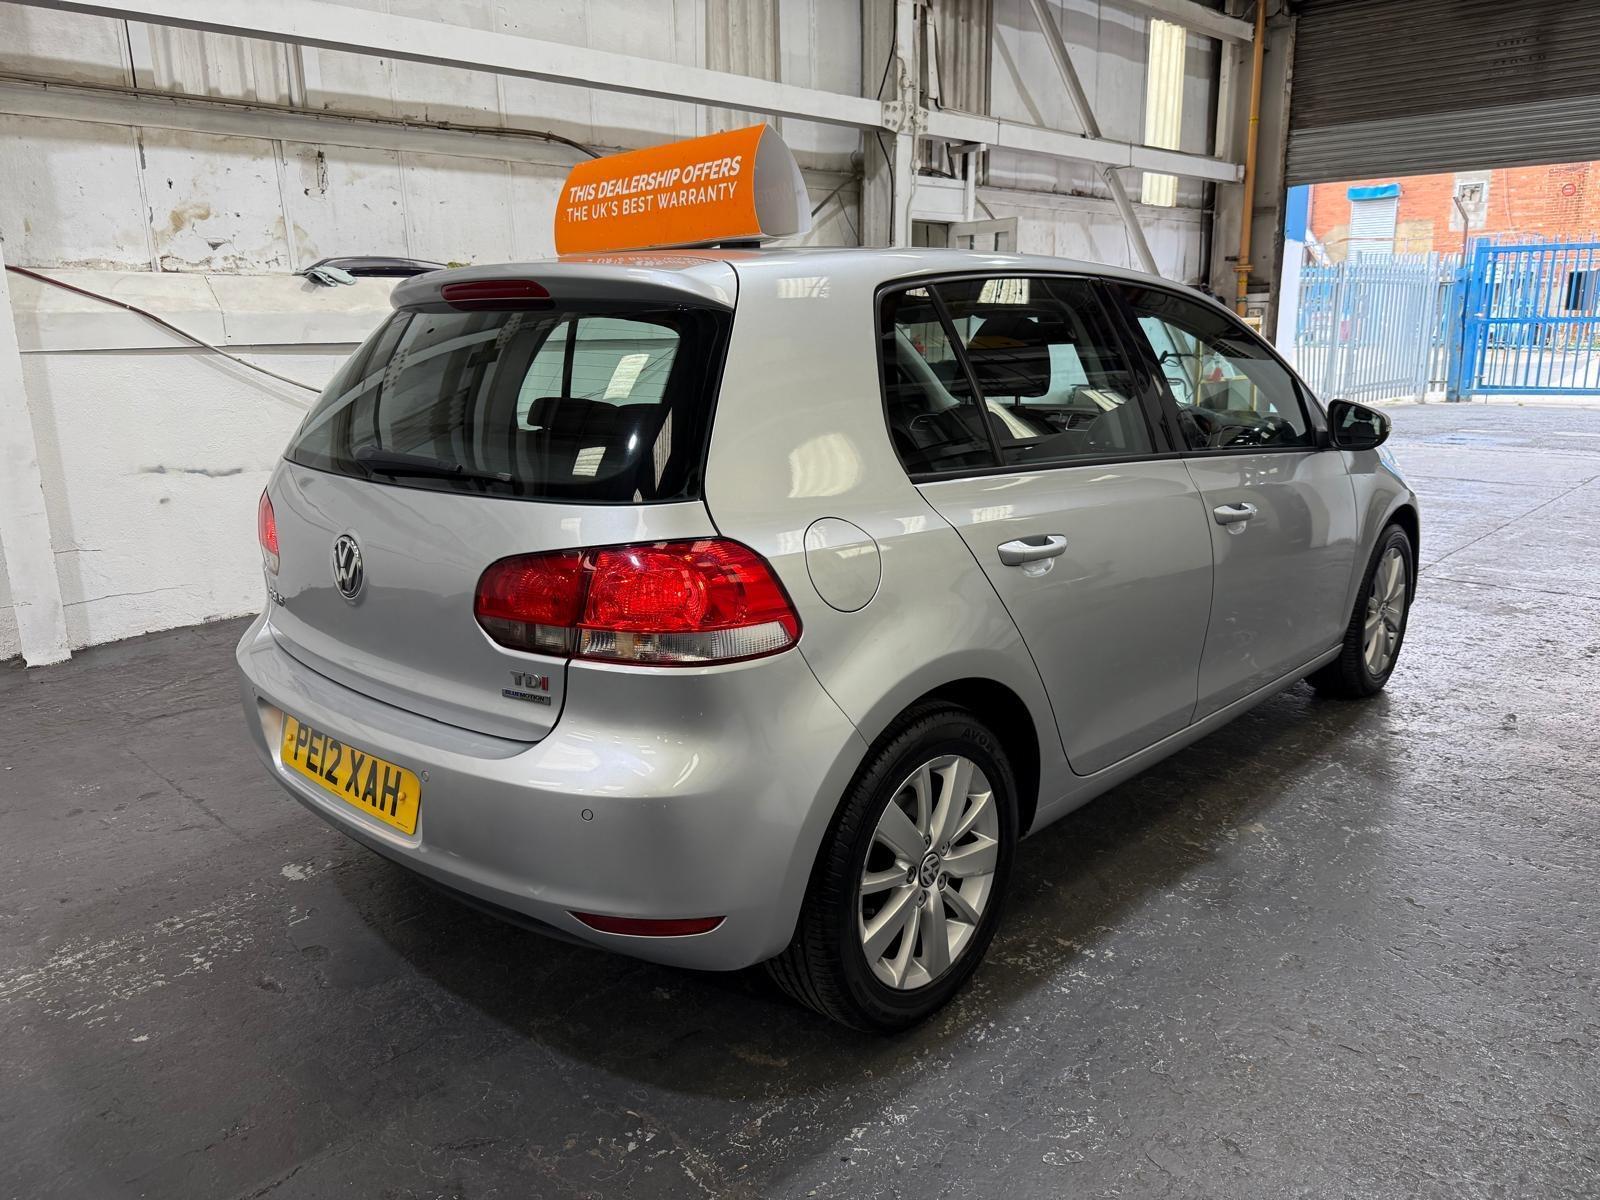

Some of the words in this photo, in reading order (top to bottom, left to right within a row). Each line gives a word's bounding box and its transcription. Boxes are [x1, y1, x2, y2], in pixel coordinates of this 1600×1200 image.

[569, 185, 596, 203] THIS
[598, 168, 680, 198] DEALERSHIP
[682, 155, 742, 184] OFFERS
[566, 206, 588, 223] THE
[591, 200, 618, 220] UK'S
[622, 194, 654, 216] BEST
[657, 181, 738, 209] WARRANTY
[510, 670, 549, 692] TDI
[293, 722, 343, 786] PE12
[344, 749, 402, 817] XAH
